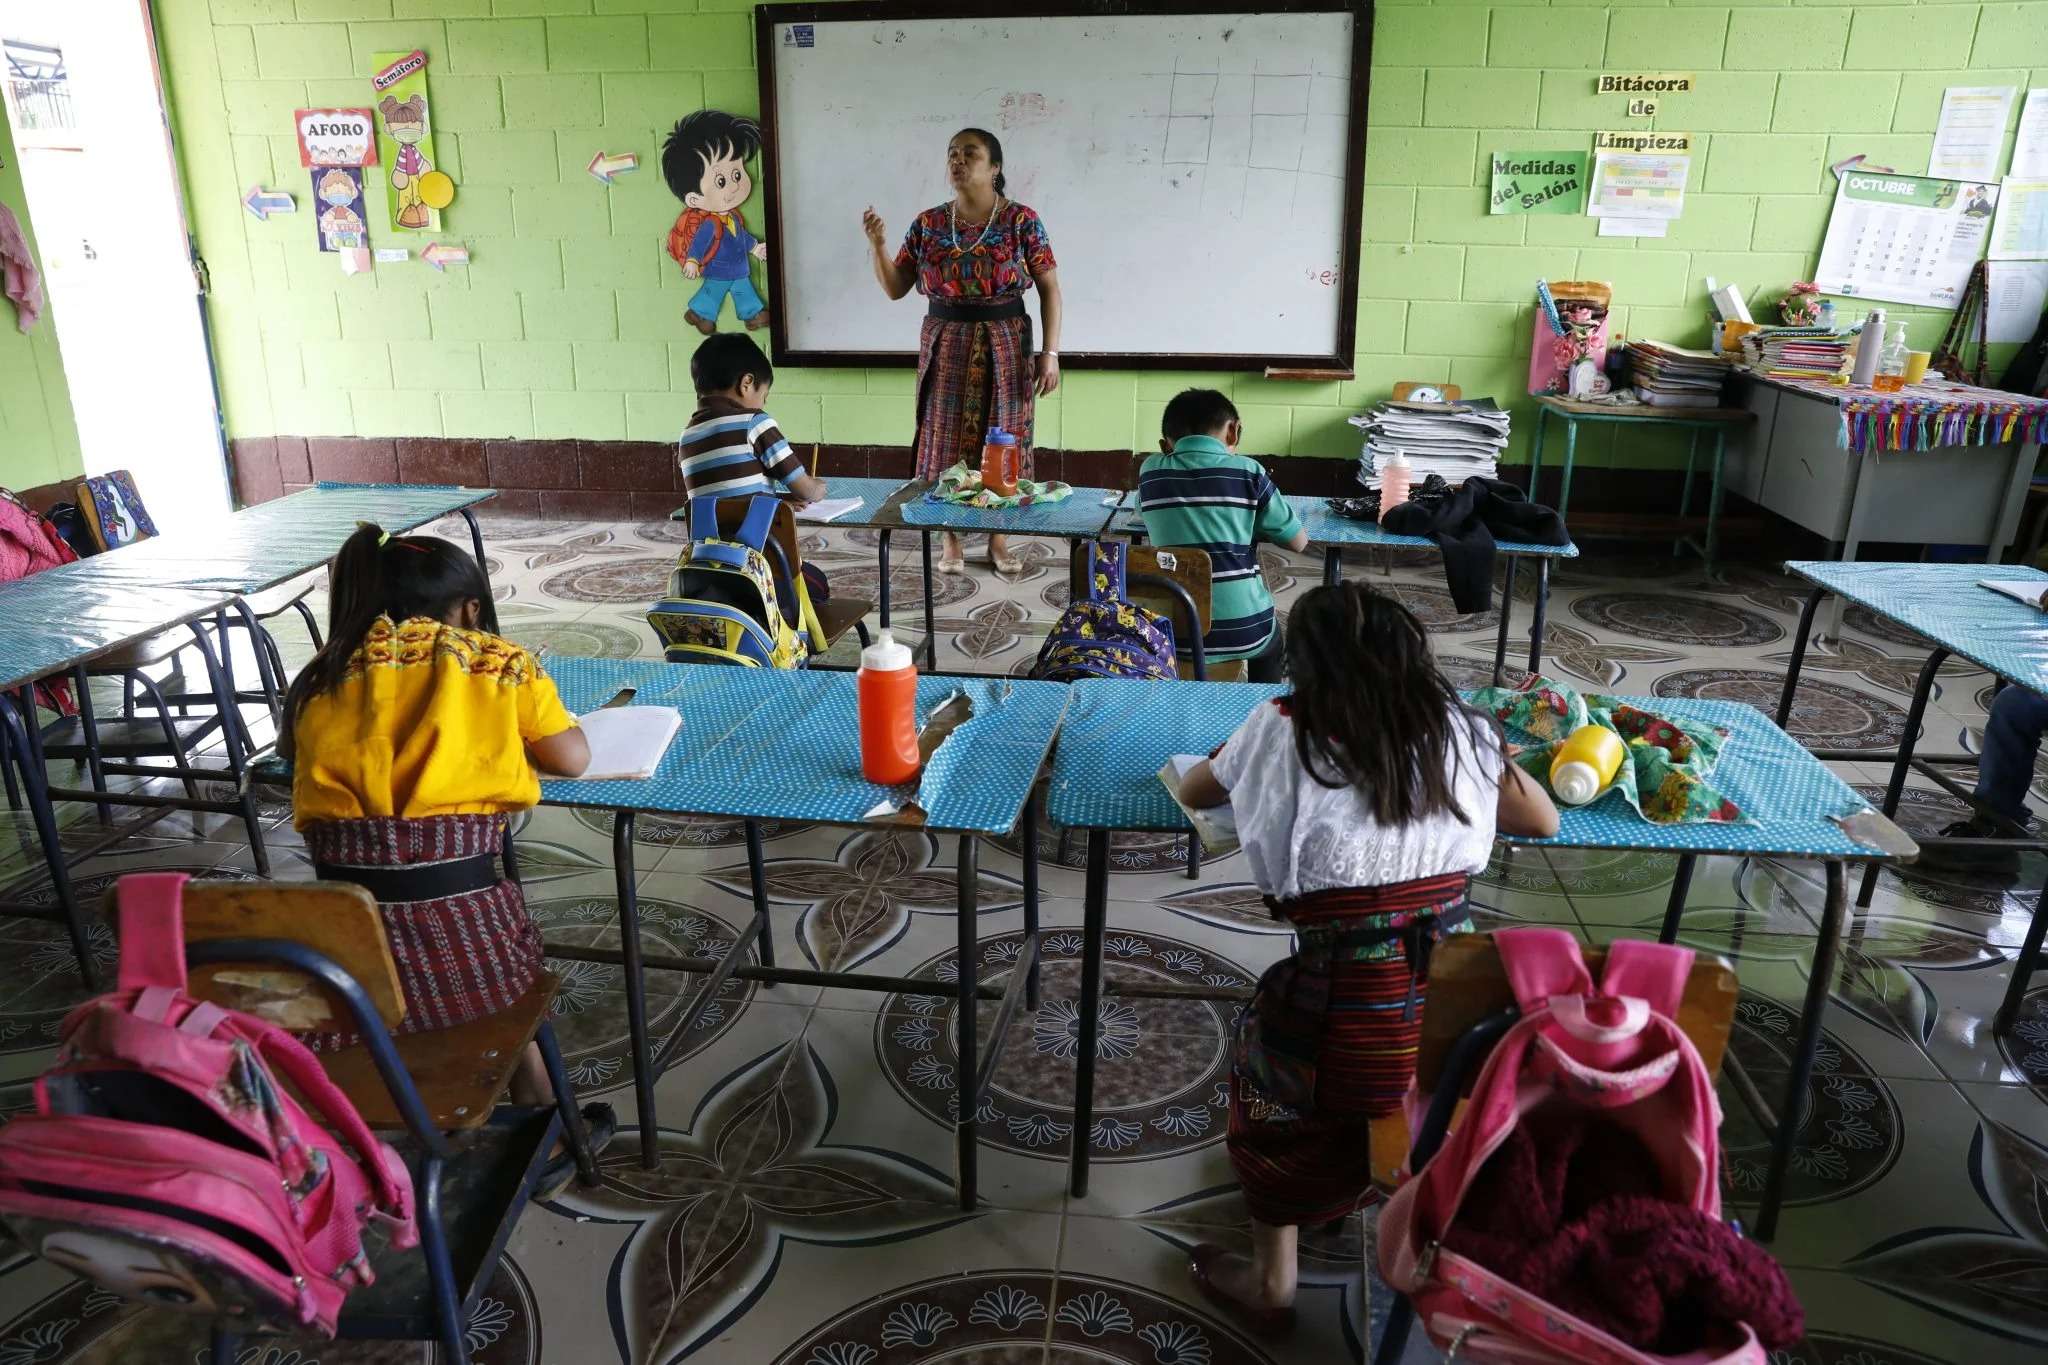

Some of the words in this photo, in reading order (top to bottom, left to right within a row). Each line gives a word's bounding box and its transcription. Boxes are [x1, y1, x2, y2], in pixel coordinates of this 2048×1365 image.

[376, 56, 423, 88] Semáforo
[1600, 76, 1689, 92] Bitácora
[1631, 101, 1655, 115] de
[308, 123, 364, 137] AFORO
[1596, 132, 1688, 151] Limpieza
[1494, 160, 1576, 176] Medidas
[1493, 181, 1521, 206] del
[1521, 178, 1578, 209] Salón
[1850, 177, 1916, 195] OCTUBRE
